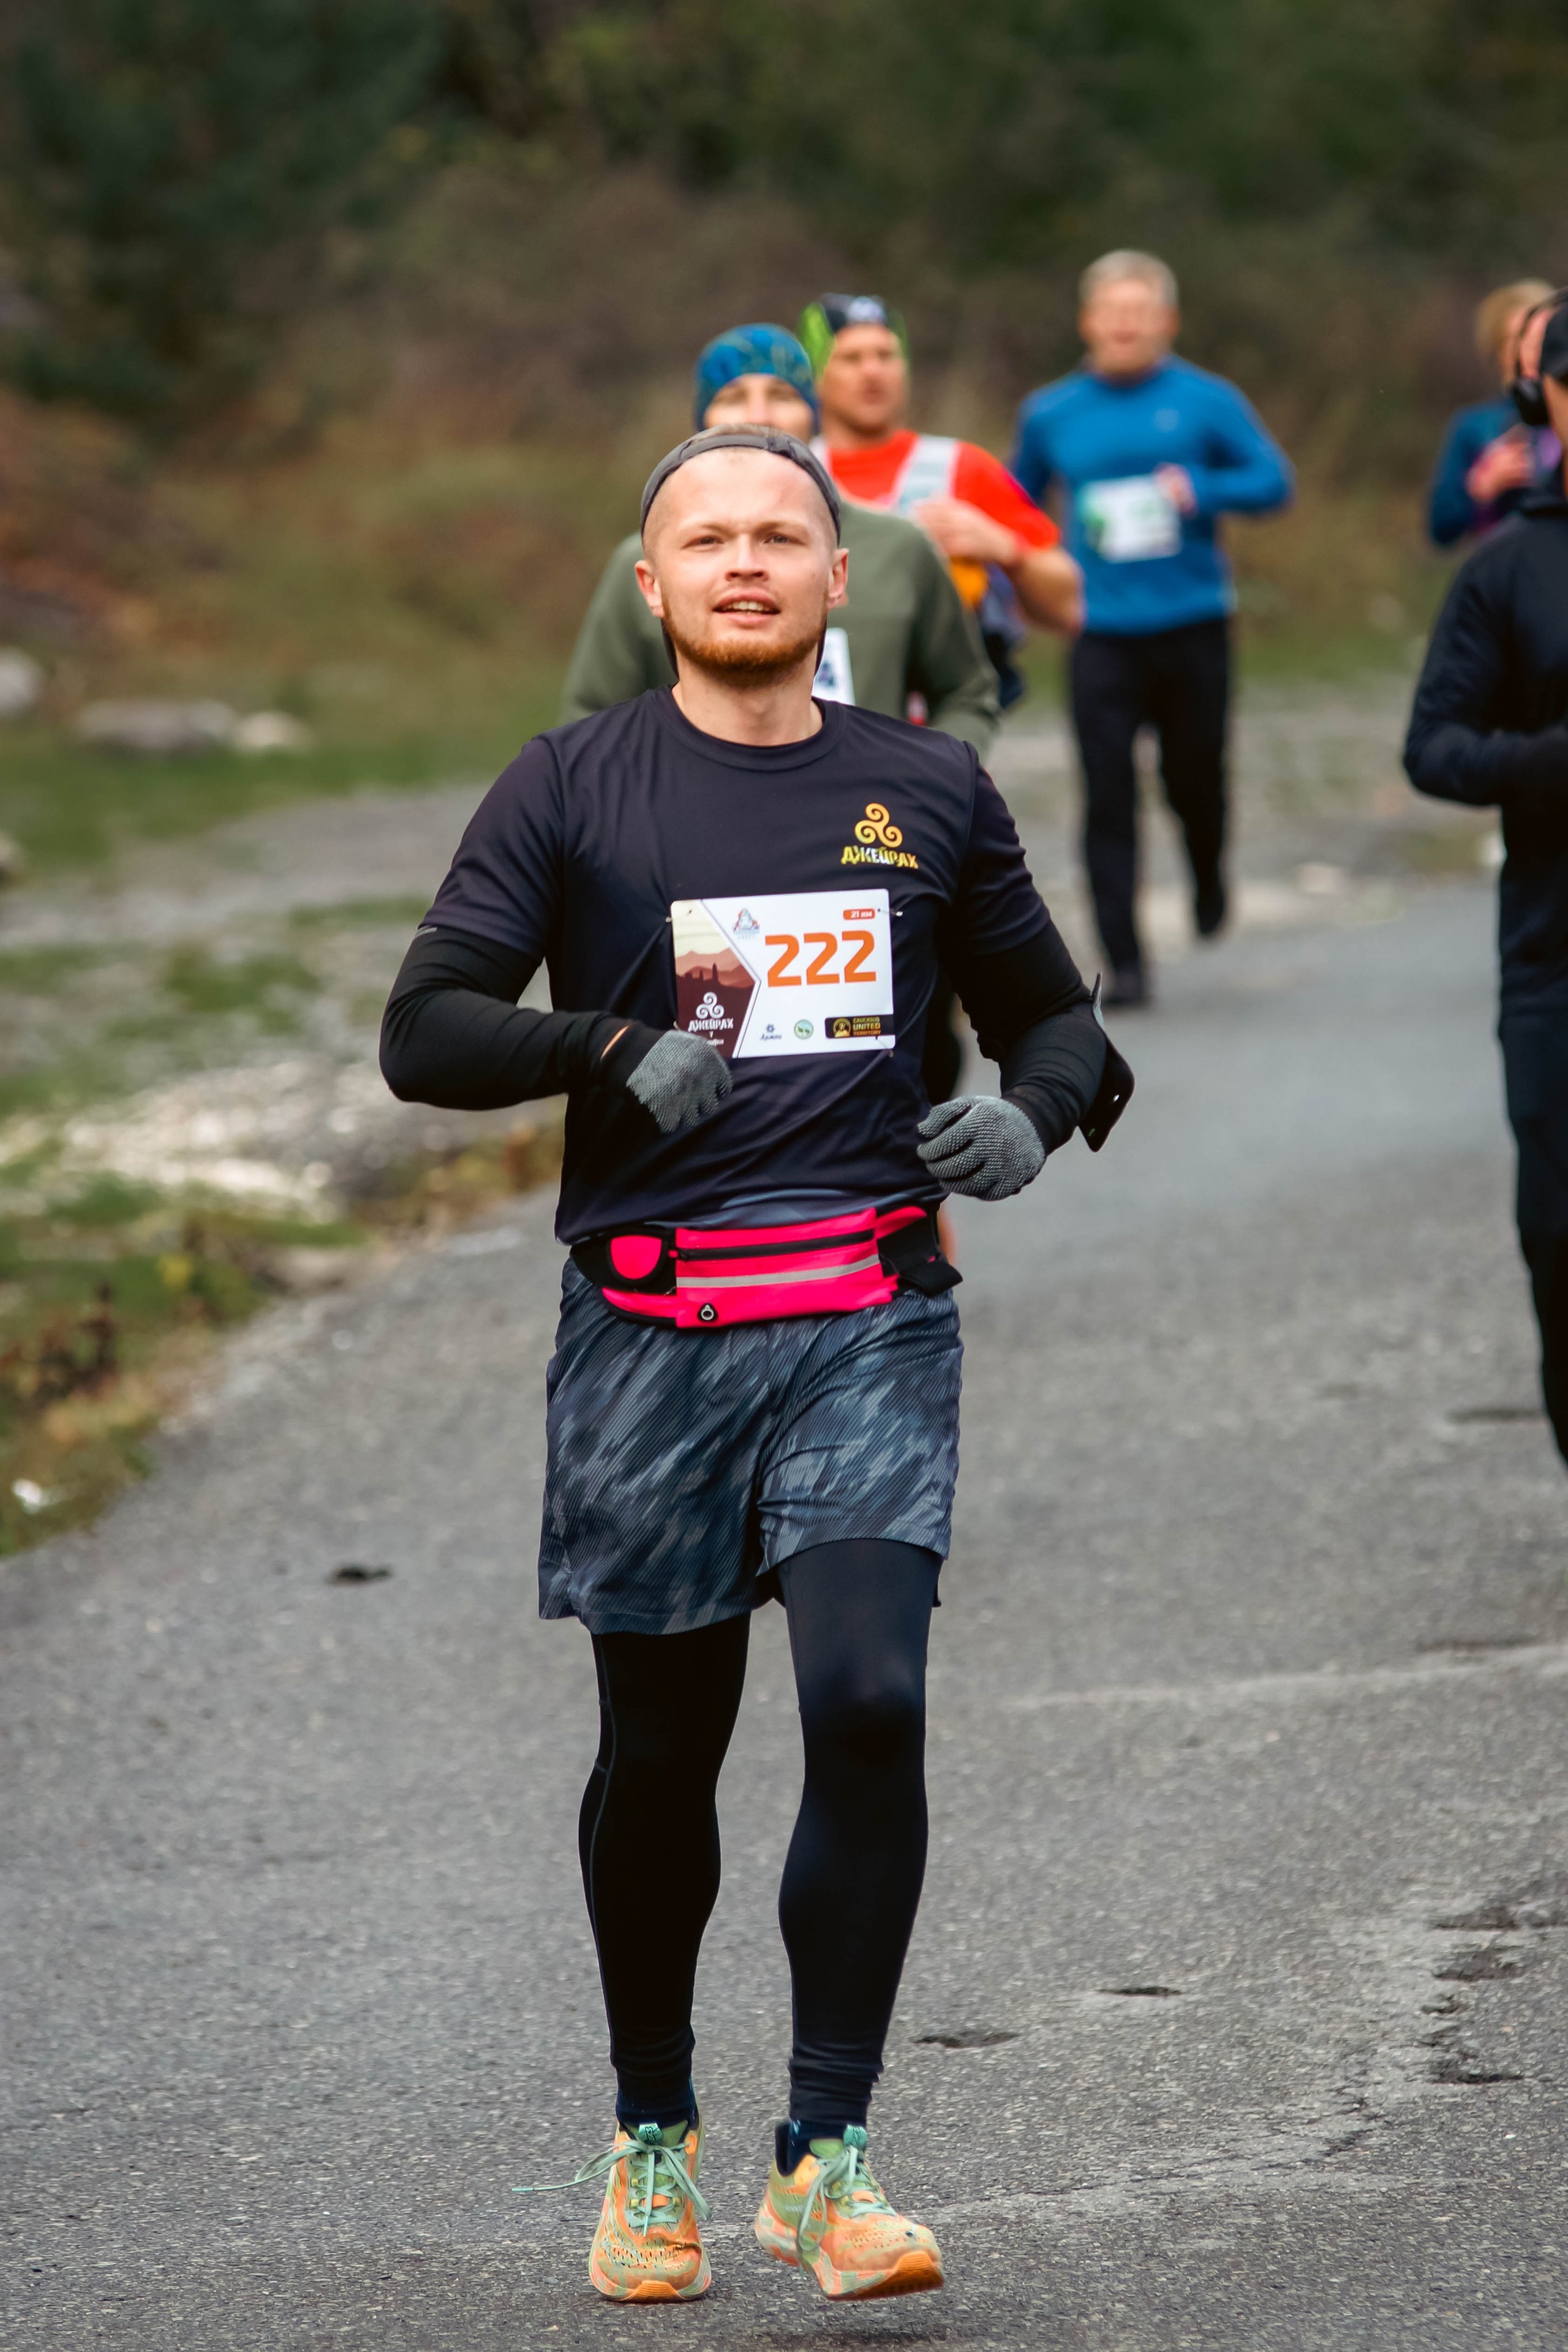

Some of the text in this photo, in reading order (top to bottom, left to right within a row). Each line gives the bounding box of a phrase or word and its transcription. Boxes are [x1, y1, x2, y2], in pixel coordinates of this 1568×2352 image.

[841, 845, 918, 869] ДЖЕЙРАХ
[765, 930, 876, 987] 222
[688, 1018, 734, 1032] ДЖЕЙРАХ
[853, 1022, 881, 1031] UNITED
